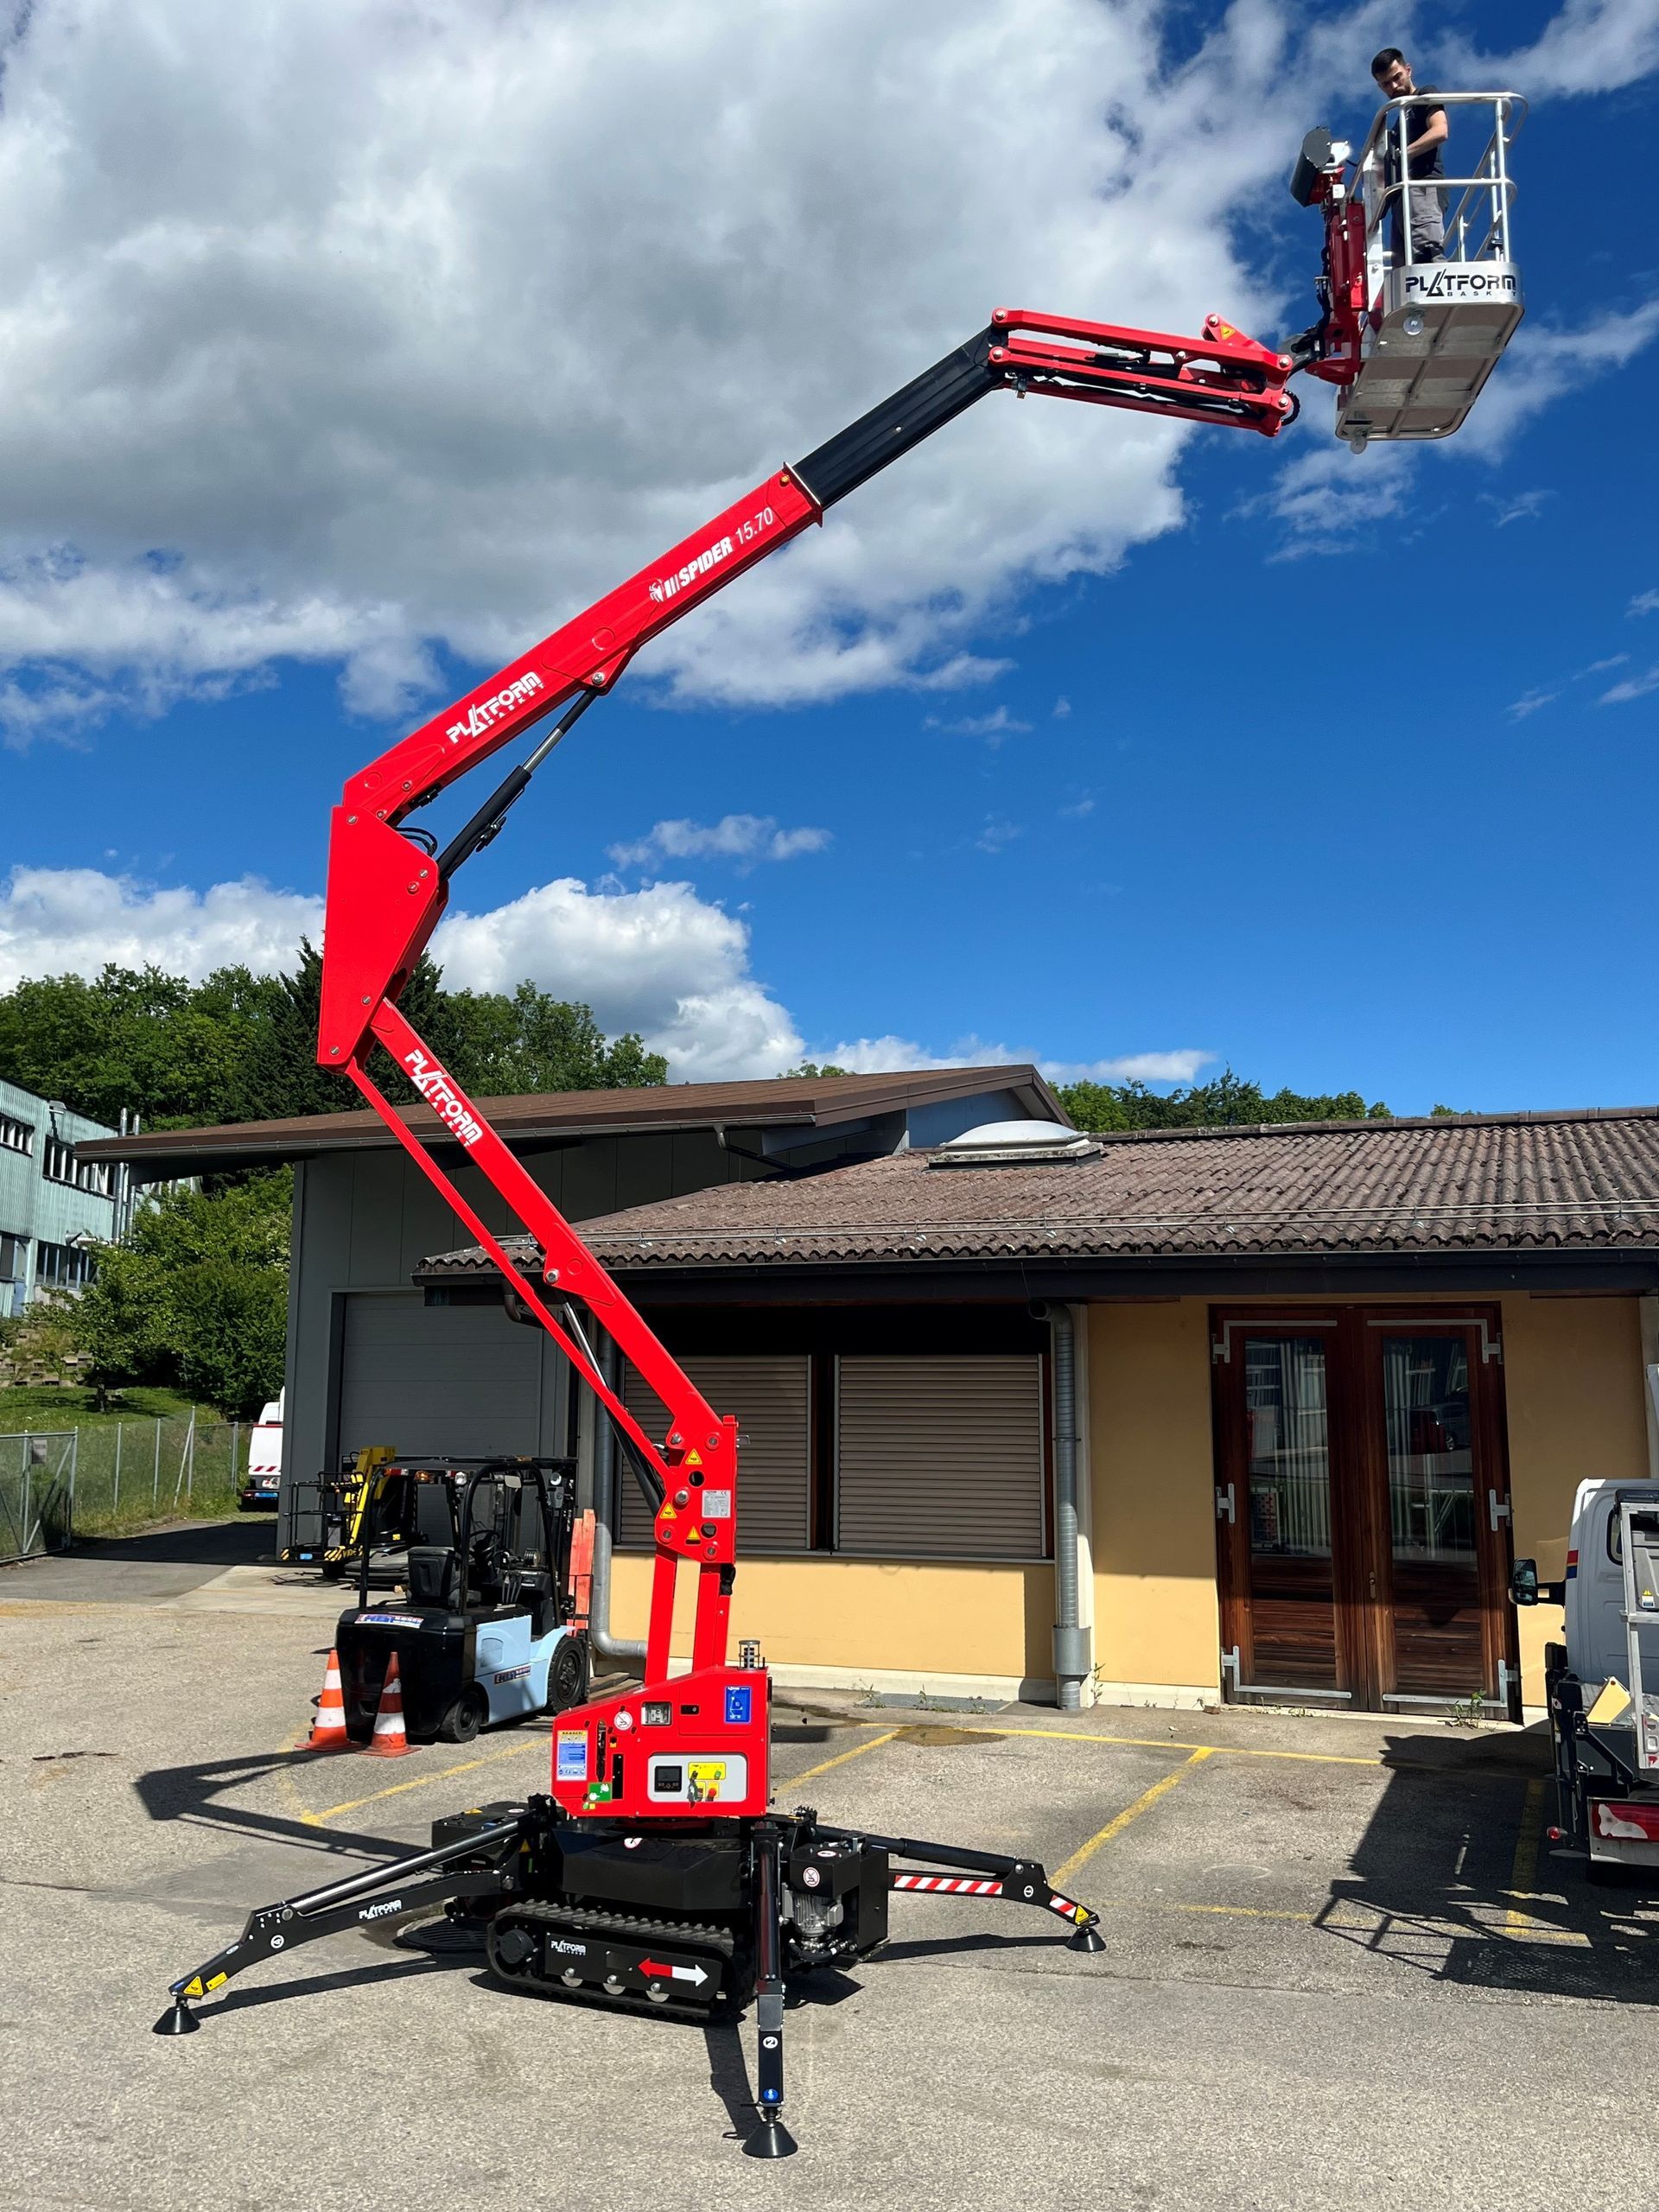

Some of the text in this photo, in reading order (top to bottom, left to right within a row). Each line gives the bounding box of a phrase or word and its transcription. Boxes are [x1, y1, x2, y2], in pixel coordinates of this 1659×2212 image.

[1405, 269, 1516, 297] PLATFORM
[678, 506, 773, 588] SPIDER 15.70
[445, 671, 543, 744] PLATFORM
[404, 1048, 484, 1145] PLATFORM
[358, 1899, 402, 1920] PLATFORM
[550, 1939, 586, 1953] PLATFORM
